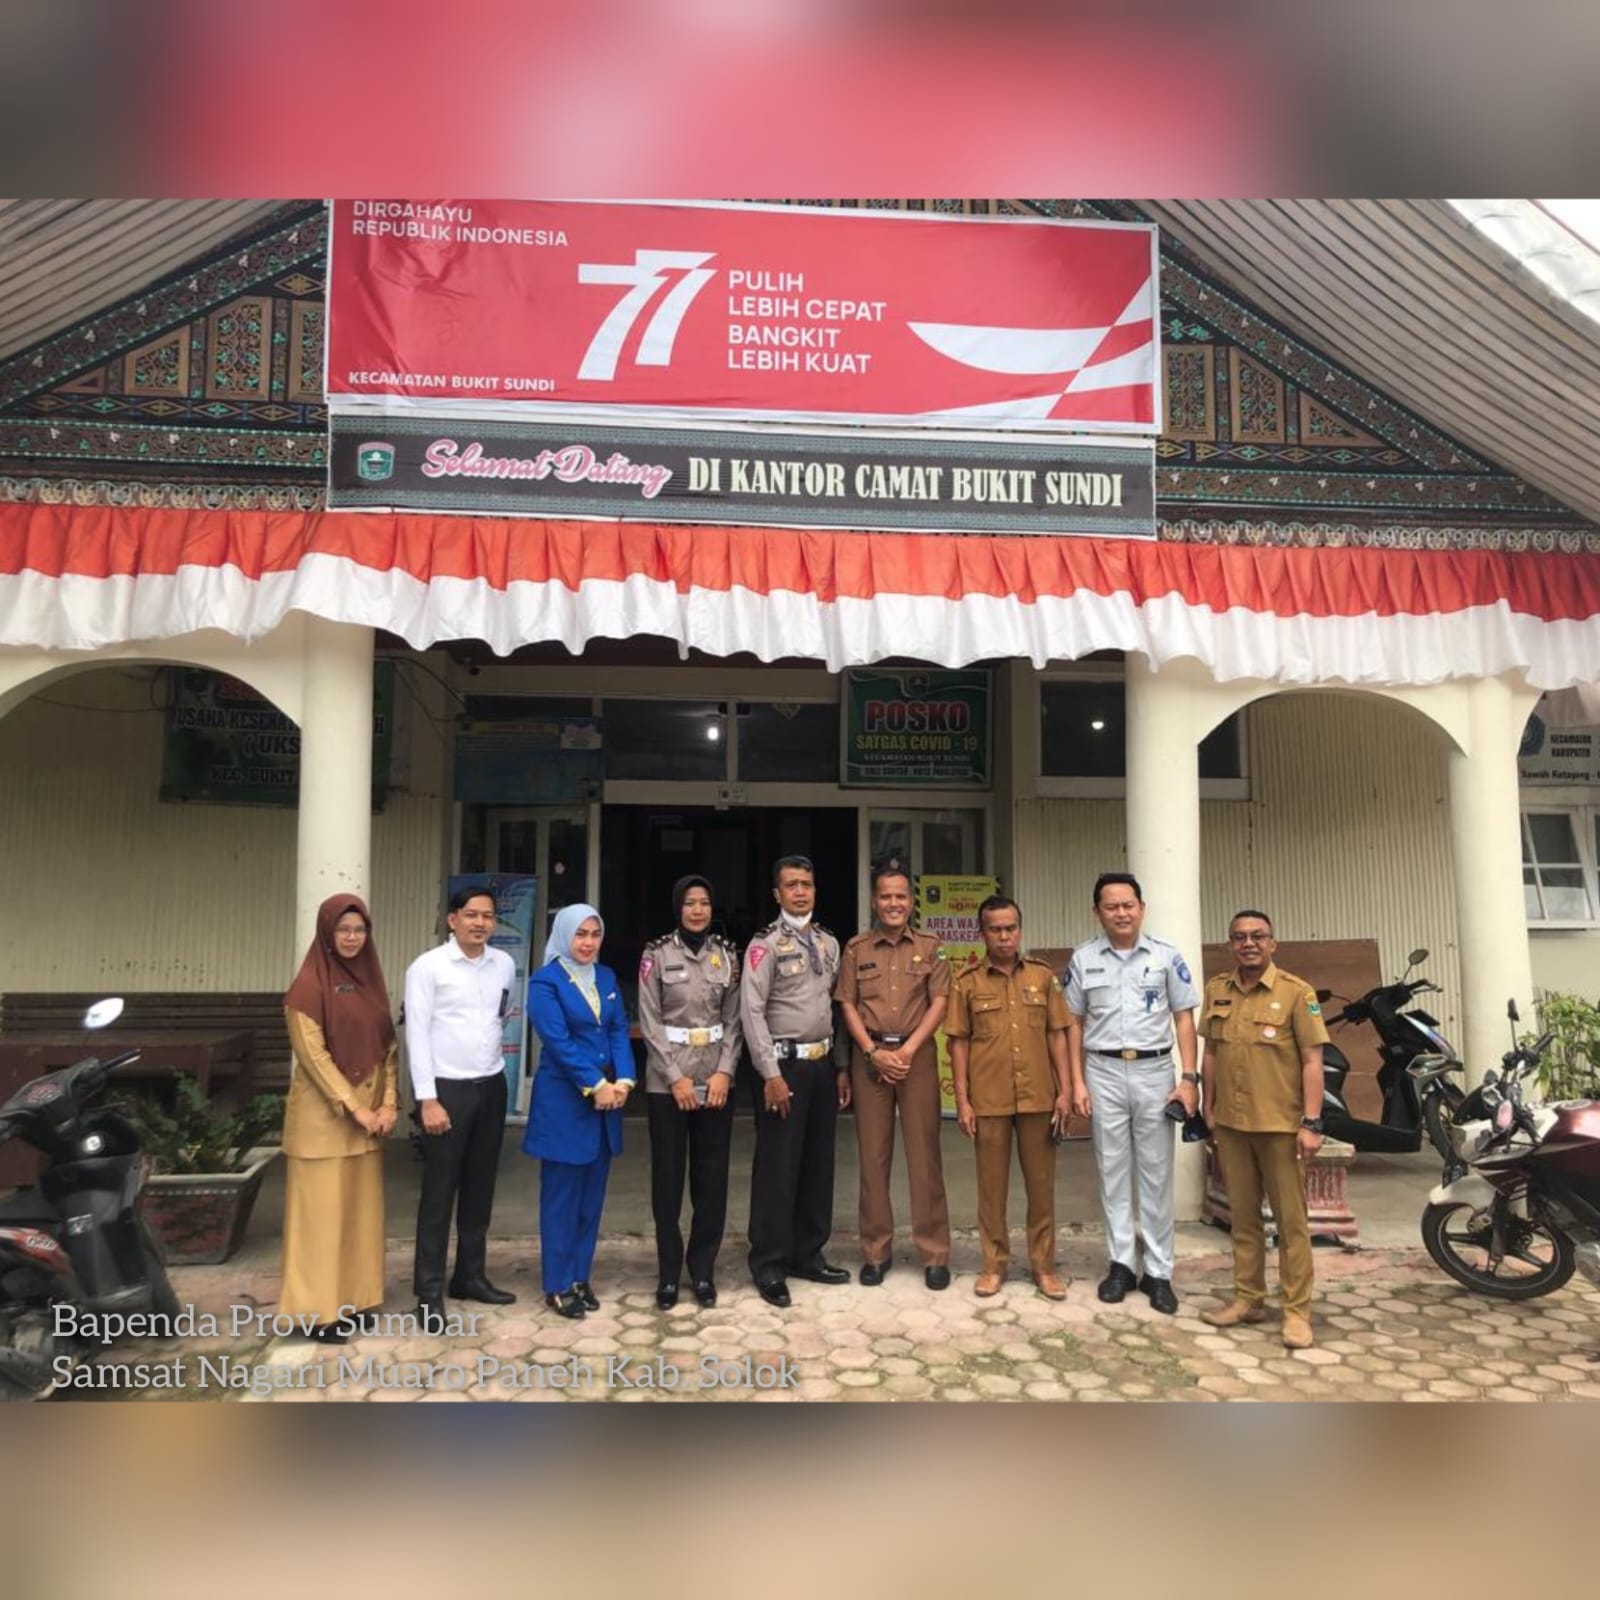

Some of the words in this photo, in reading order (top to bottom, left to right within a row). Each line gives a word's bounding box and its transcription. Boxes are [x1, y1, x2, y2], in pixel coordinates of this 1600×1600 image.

[353, 201, 472, 224] DIRGAHAYU
[353, 220, 451, 241] REPUBLIK
[456, 226, 568, 247] INDONESIA
[728, 270, 804, 293] PULIH
[577, 249, 717, 381] 77
[728, 296, 799, 319] LEBIH
[805, 299, 887, 322] CEPAT
[728, 324, 841, 348] BANGKIT
[728, 349, 799, 372] LEBIH
[805, 352, 871, 374] KUAT
[348, 371, 447, 389] KECAMATAN
[451, 374, 500, 391] BUKIT
[503, 377, 556, 393] SUNDI
[421, 439, 553, 479] Selamat
[552, 445, 673, 498] Datang
[688, 457, 721, 492] DI
[730, 459, 846, 497] KANTOR
[855, 465, 943, 501] CAMAT
[952, 467, 1036, 504] BUKIT
[1045, 472, 1124, 507] SUNDI
[864, 700, 971, 733] POSKO
[855, 735, 908, 751] SATGAS
[909, 735, 952, 751] COVID
[927, 917, 953, 929] AREA
[957, 917, 980, 929] WAJ
